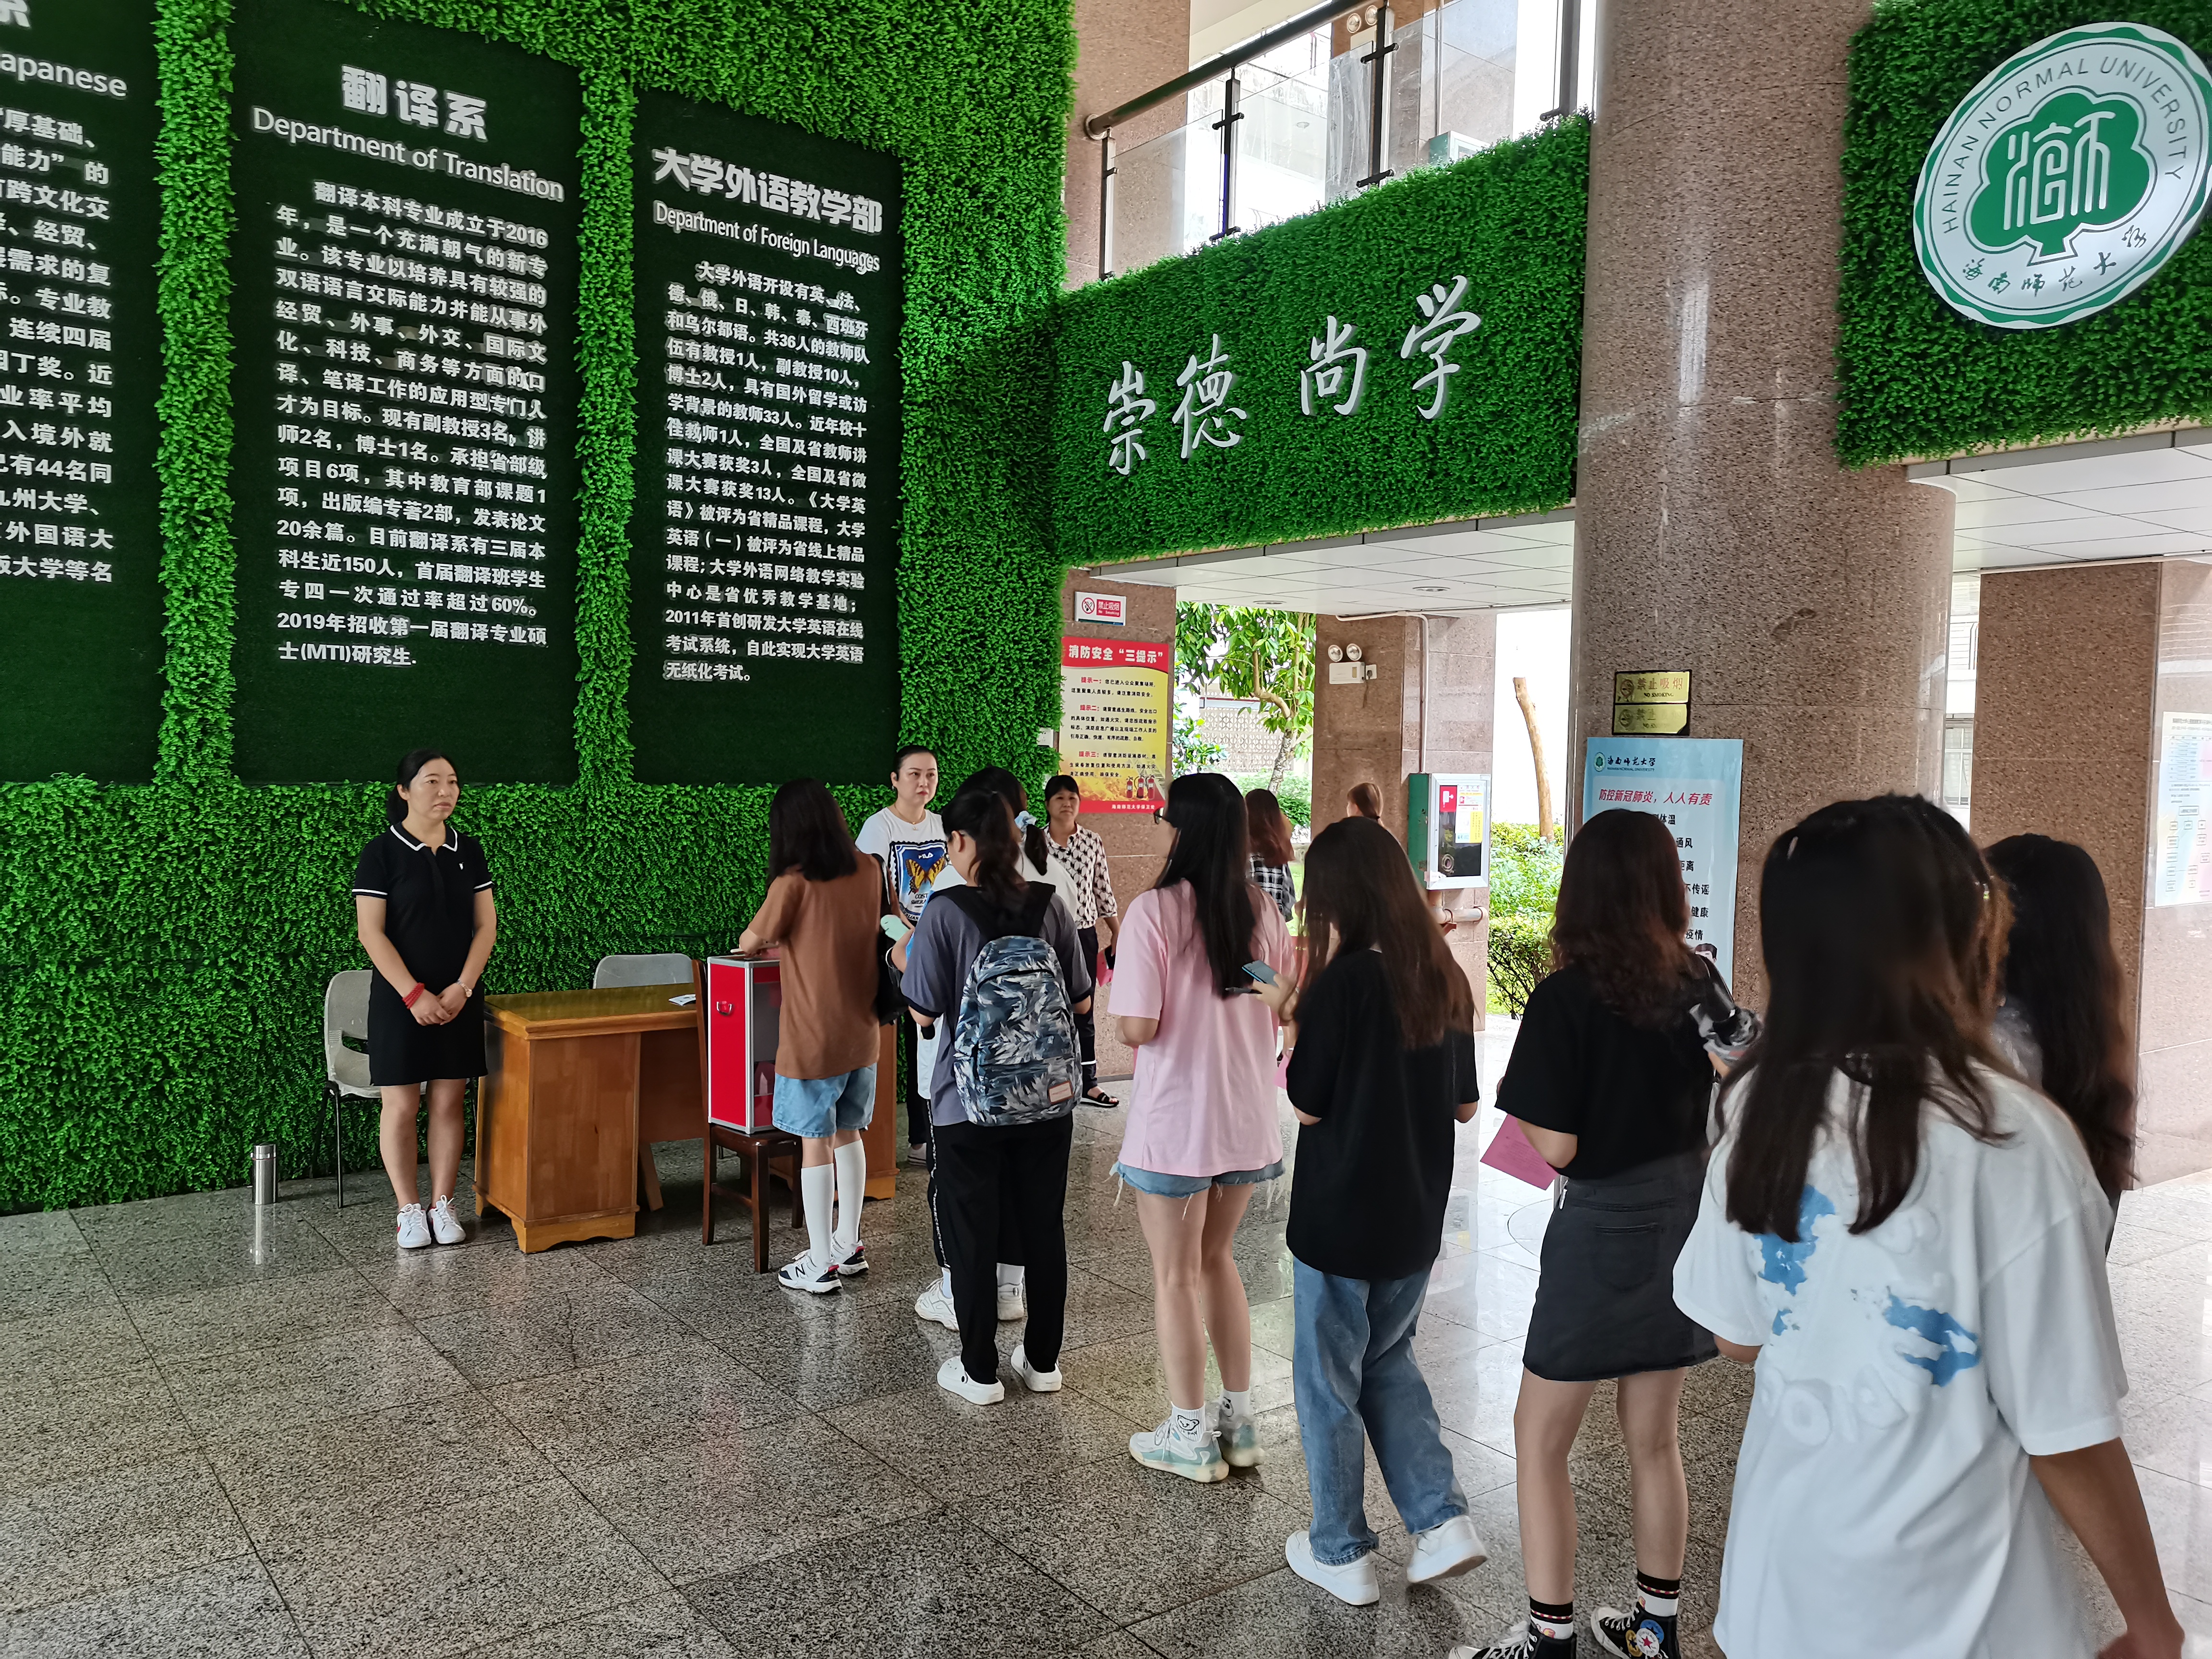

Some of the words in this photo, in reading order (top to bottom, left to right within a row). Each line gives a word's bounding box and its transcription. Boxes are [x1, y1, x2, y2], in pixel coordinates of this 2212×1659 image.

[342, 65, 487, 140] 翻译系
[1942, 134, 1980, 234] HAINAN
[1977, 58, 2090, 130] NORMAL
[2099, 56, 2188, 181] UNIVERSITY
[254, 108, 406, 163] Department
[412, 148, 438, 169] of
[443, 152, 563, 200] Translation
[655, 148, 882, 233] 大学外语教学部
[657, 202, 740, 240] Department
[743, 224, 758, 243] of
[761, 227, 810, 257] Foreign
[814, 239, 880, 275] Languages
[1097, 601, 1120, 611] 禁止吸烟
[1636, 677, 1683, 691] 禁止吸烟
[1599, 789, 1713, 805] 防控新冠肺炎，人人有责
[1658, 813, 1676, 825] 体温
[1676, 837, 1694, 849] 通风
[1691, 905, 1709, 918] 健康
